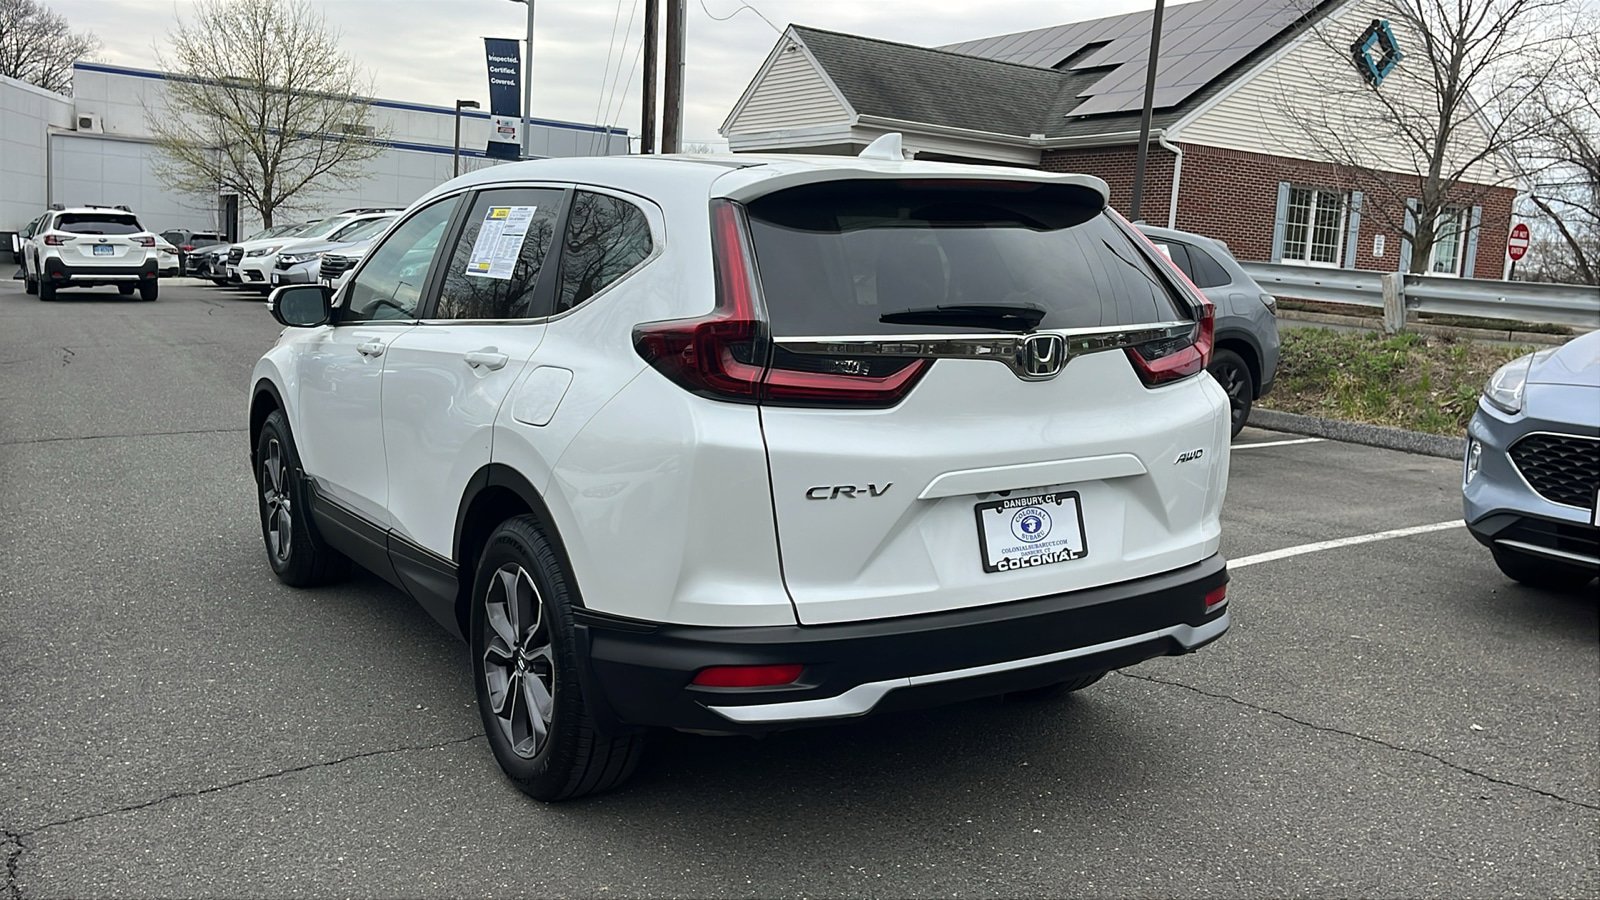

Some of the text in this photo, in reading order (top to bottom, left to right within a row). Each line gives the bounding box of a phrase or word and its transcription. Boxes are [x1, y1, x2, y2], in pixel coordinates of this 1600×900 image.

[488, 54, 518, 63] Inspected.
[490, 66, 516, 75] Certified.
[491, 77, 516, 86] Covered.
[1512, 230, 1528, 239] DO NOT
[1511, 247, 1524, 255] ENTER
[1173, 448, 1204, 465] AWD
[805, 481, 894, 501] CR-V
[1045, 494, 1056, 503] CT
[1015, 509, 1046, 523] COLONIAL
[1021, 530, 1046, 541] SUBARU
[1001, 539, 1068, 554] COLONIALSUBARUCT.COM
[997, 550, 1079, 572] COLONIAL
